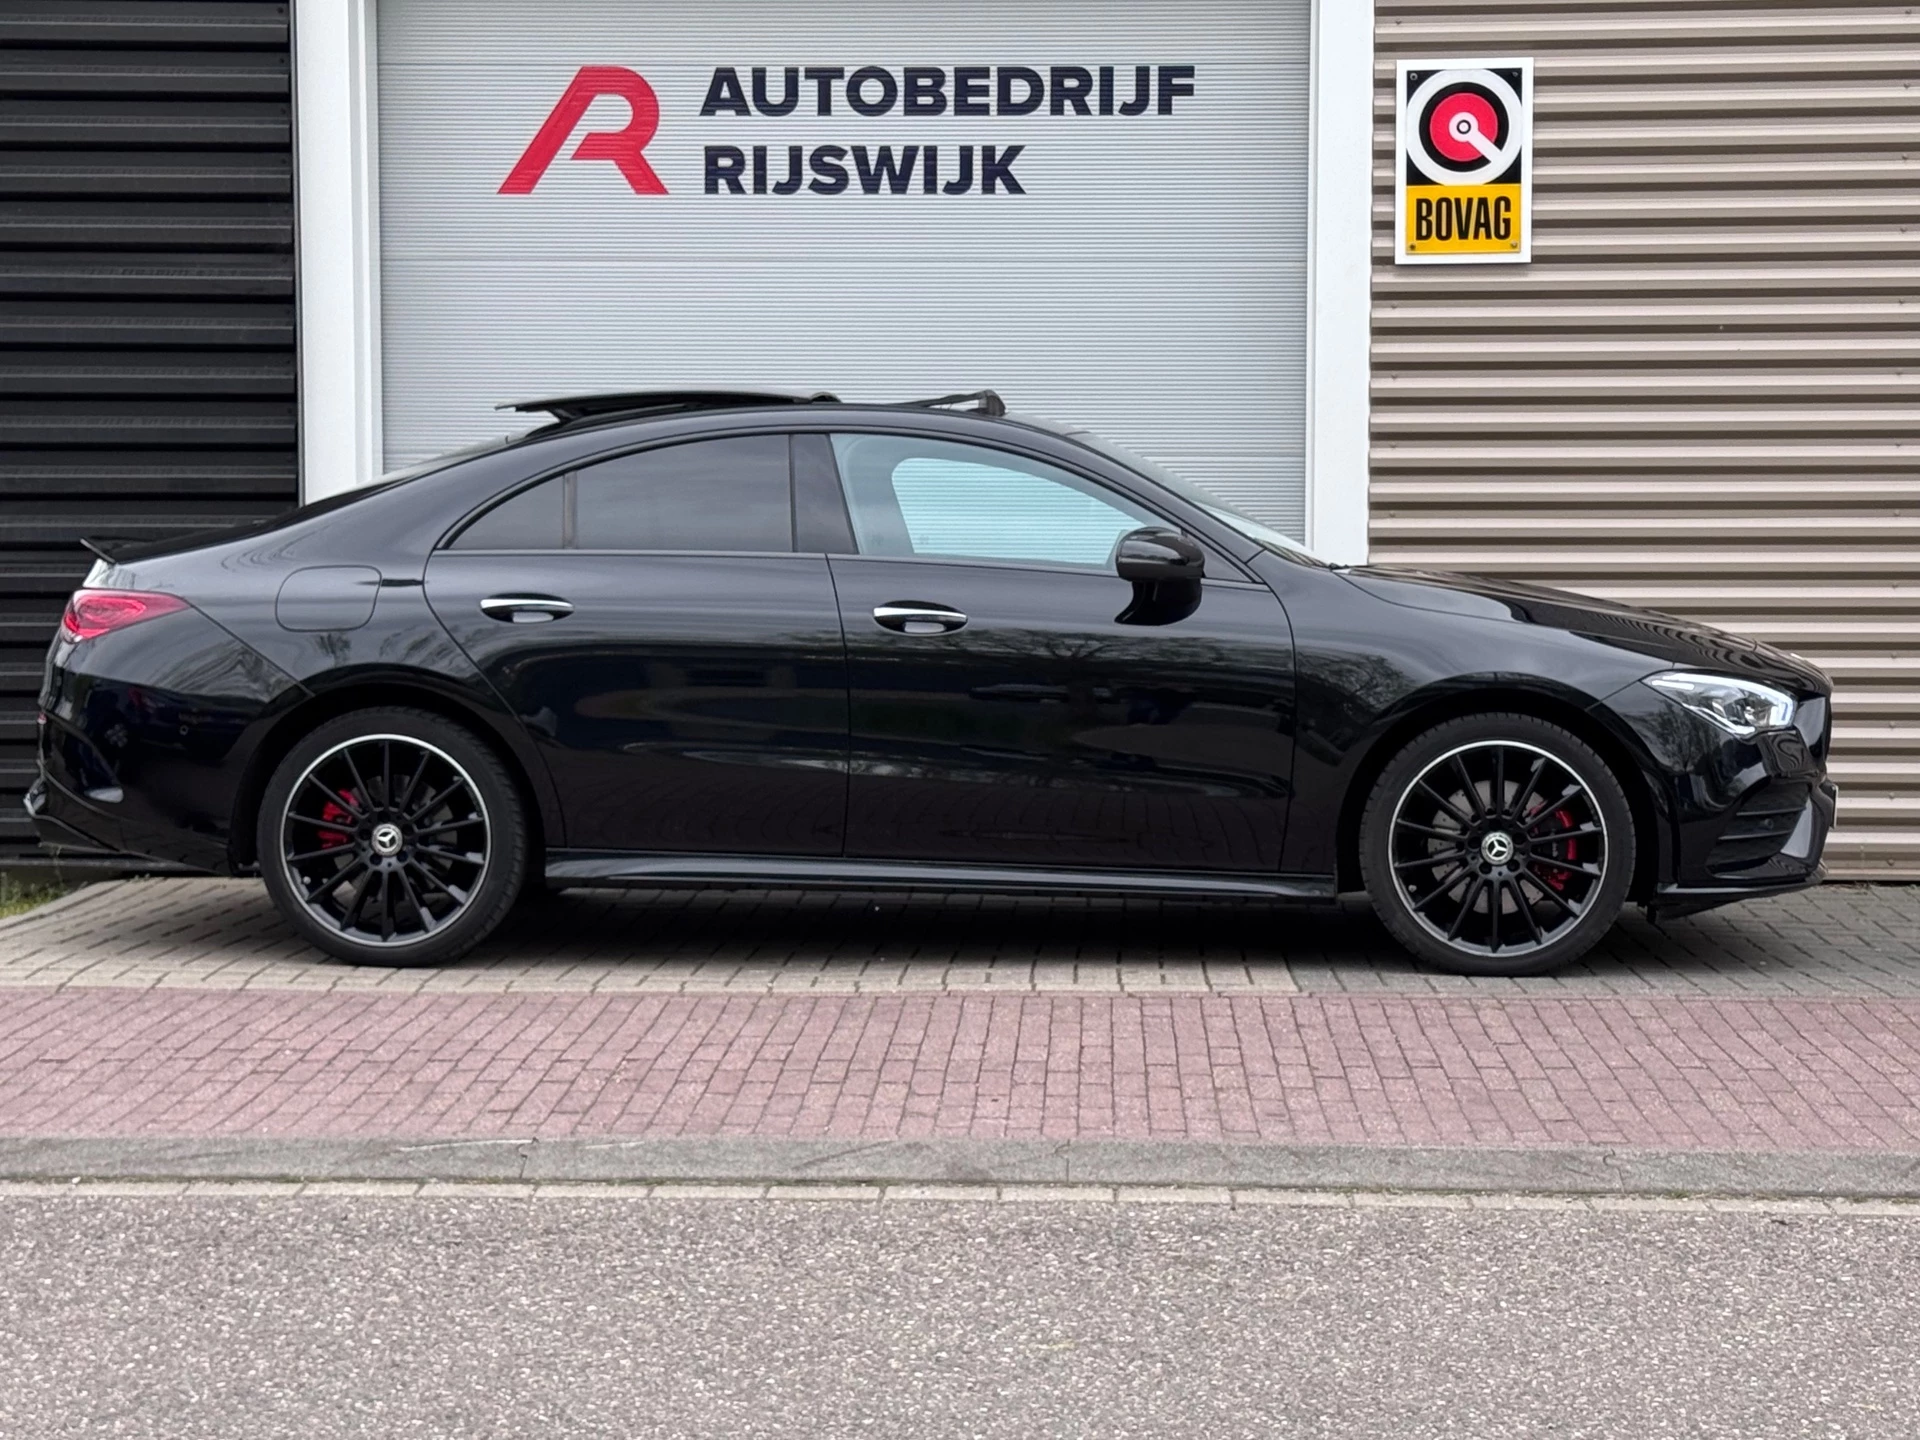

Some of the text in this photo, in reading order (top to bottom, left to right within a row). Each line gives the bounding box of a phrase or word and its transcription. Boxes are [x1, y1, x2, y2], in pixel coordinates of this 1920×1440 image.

[700, 66, 1195, 116] AUTOBEDRIJF
[704, 145, 1027, 195] RIJSWIJK
[1415, 196, 1511, 241] BOVAG
